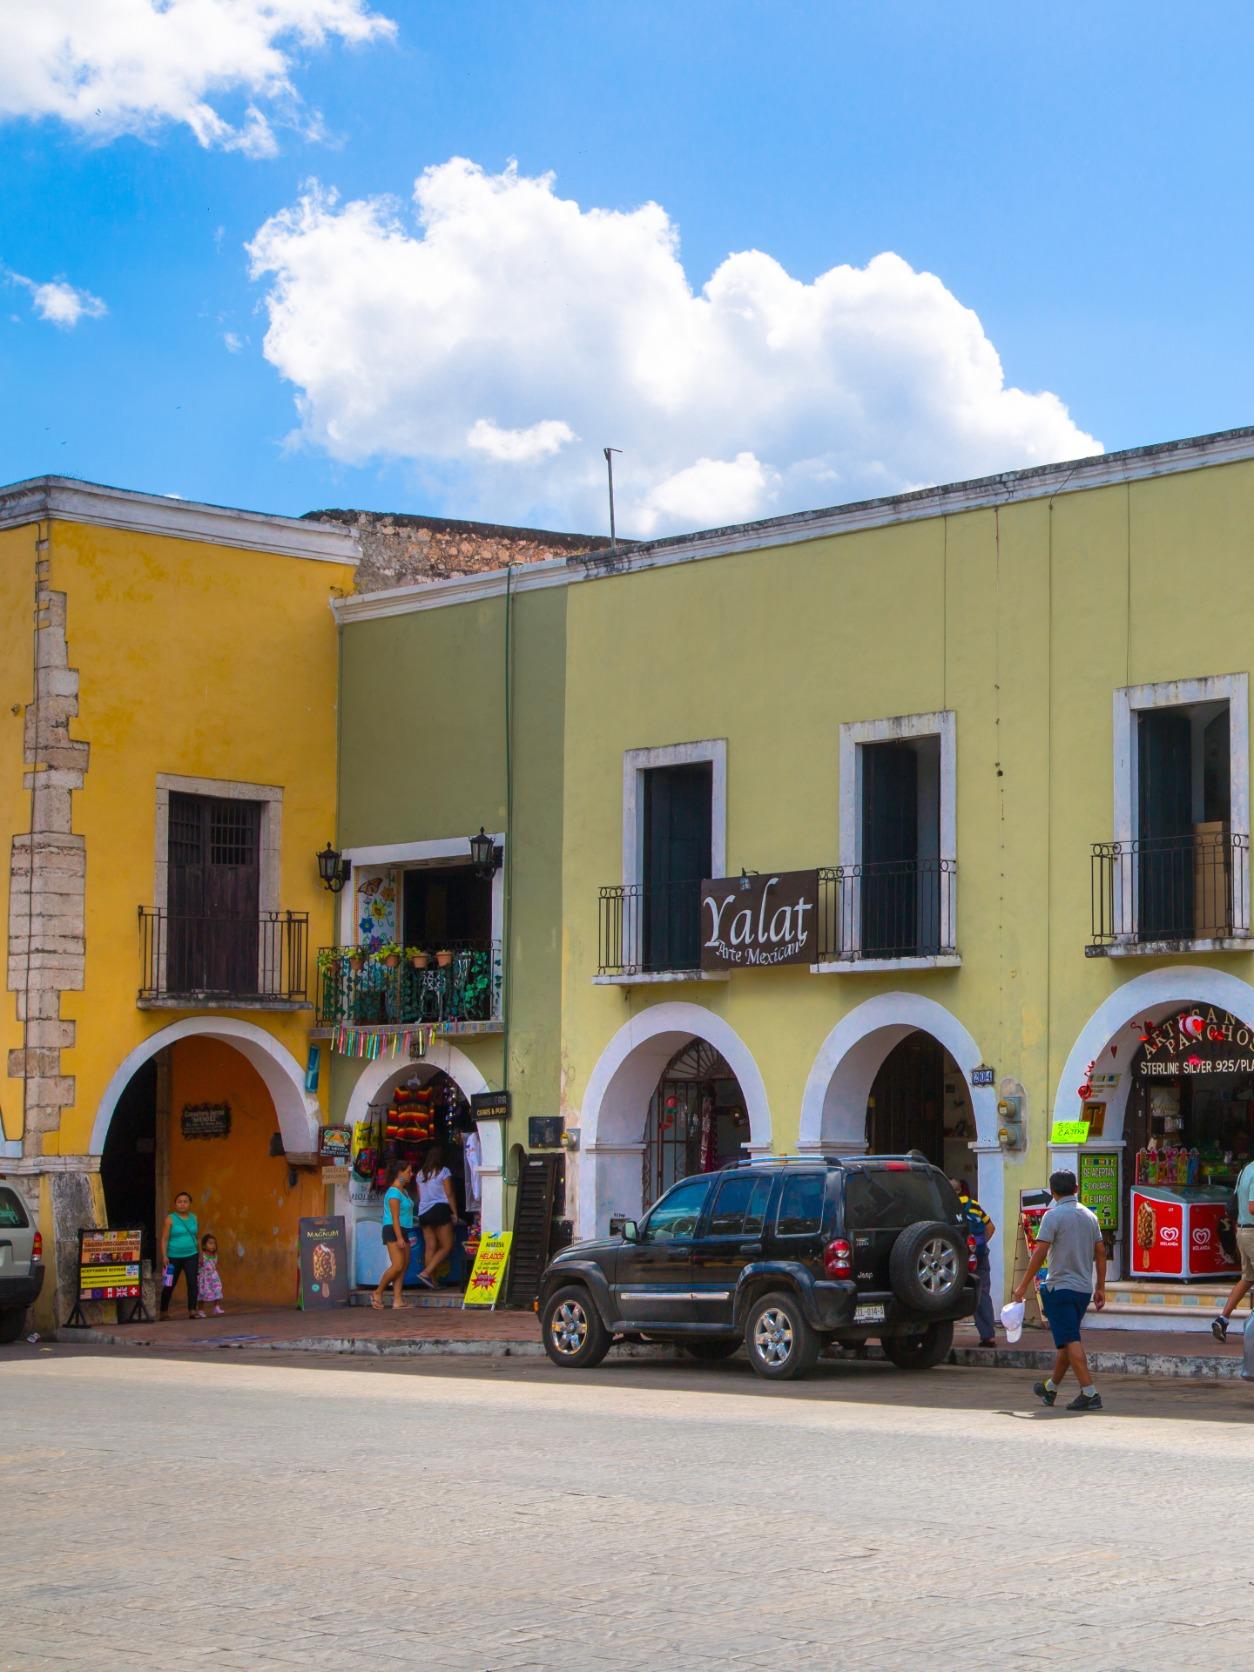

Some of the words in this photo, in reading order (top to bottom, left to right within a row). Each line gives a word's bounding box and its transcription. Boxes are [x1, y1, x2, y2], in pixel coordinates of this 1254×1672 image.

[703, 877, 814, 947] Yalat
[715, 939, 742, 962] Arte
[744, 937, 807, 965] Mexicano
[973, 1070, 993, 1083] 204
[306, 1230, 339, 1239] MAGNUM
[857, 1271, 874, 1280] Jeep
